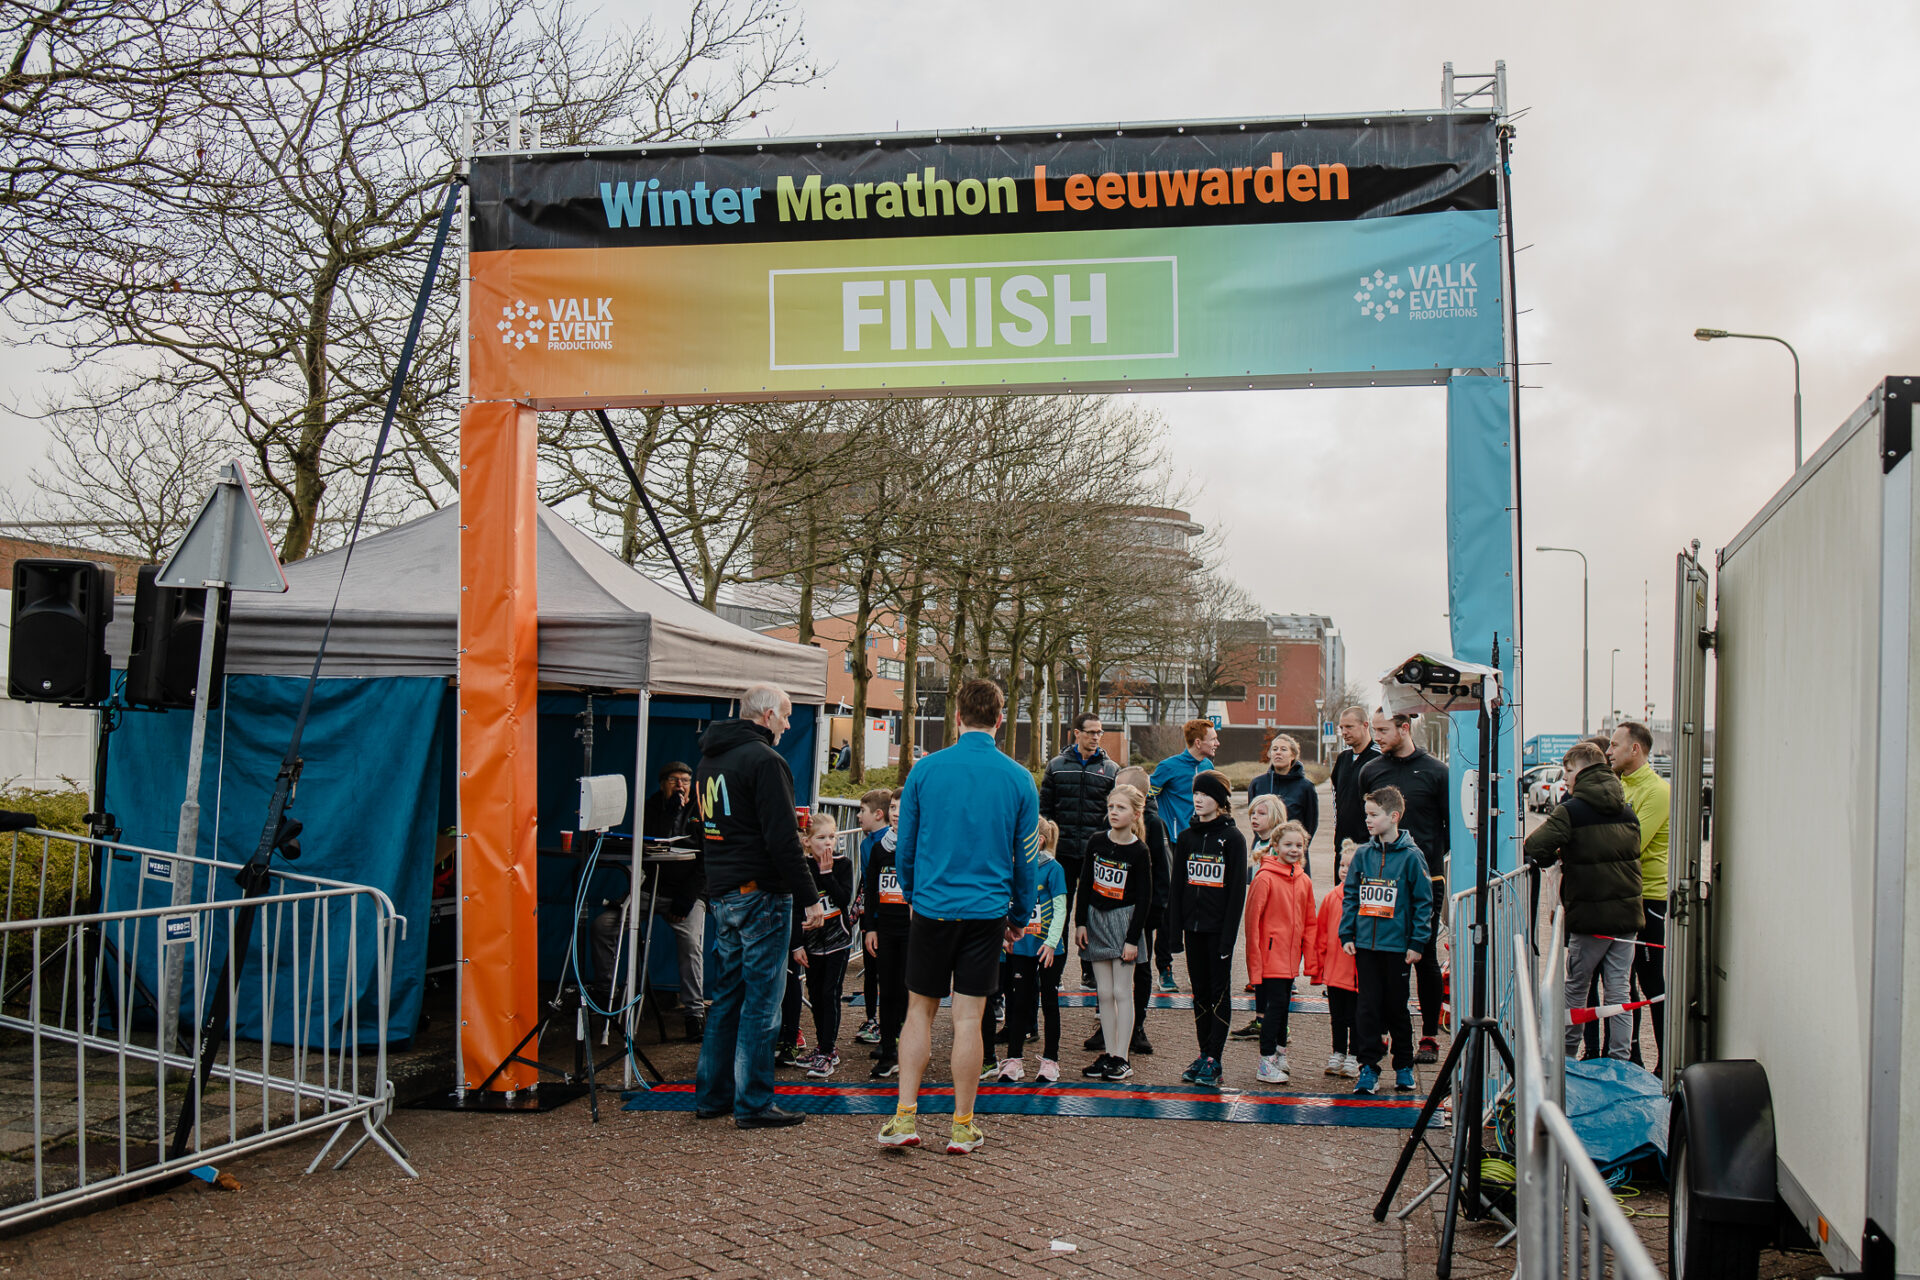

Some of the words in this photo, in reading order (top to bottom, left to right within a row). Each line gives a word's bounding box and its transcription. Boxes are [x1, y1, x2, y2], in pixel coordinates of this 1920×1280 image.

[600, 178, 762, 229] Winter
[776, 166, 1019, 222] Marathon
[1034, 151, 1350, 212] Leeuwarden
[1407, 262, 1478, 290] VALK
[547, 297, 614, 322] VALK
[1409, 287, 1478, 311] EVENT
[842, 272, 1108, 352] FINISH
[1409, 307, 1478, 321] PRODUCTIONS
[548, 321, 614, 341] EVENT
[547, 340, 613, 351] PRODUCTIONS
[1094, 863, 1124, 885] 5030
[1188, 862, 1222, 879] 5000
[1360, 886, 1394, 903] 5006
[168, 923, 184, 932] WEBO
